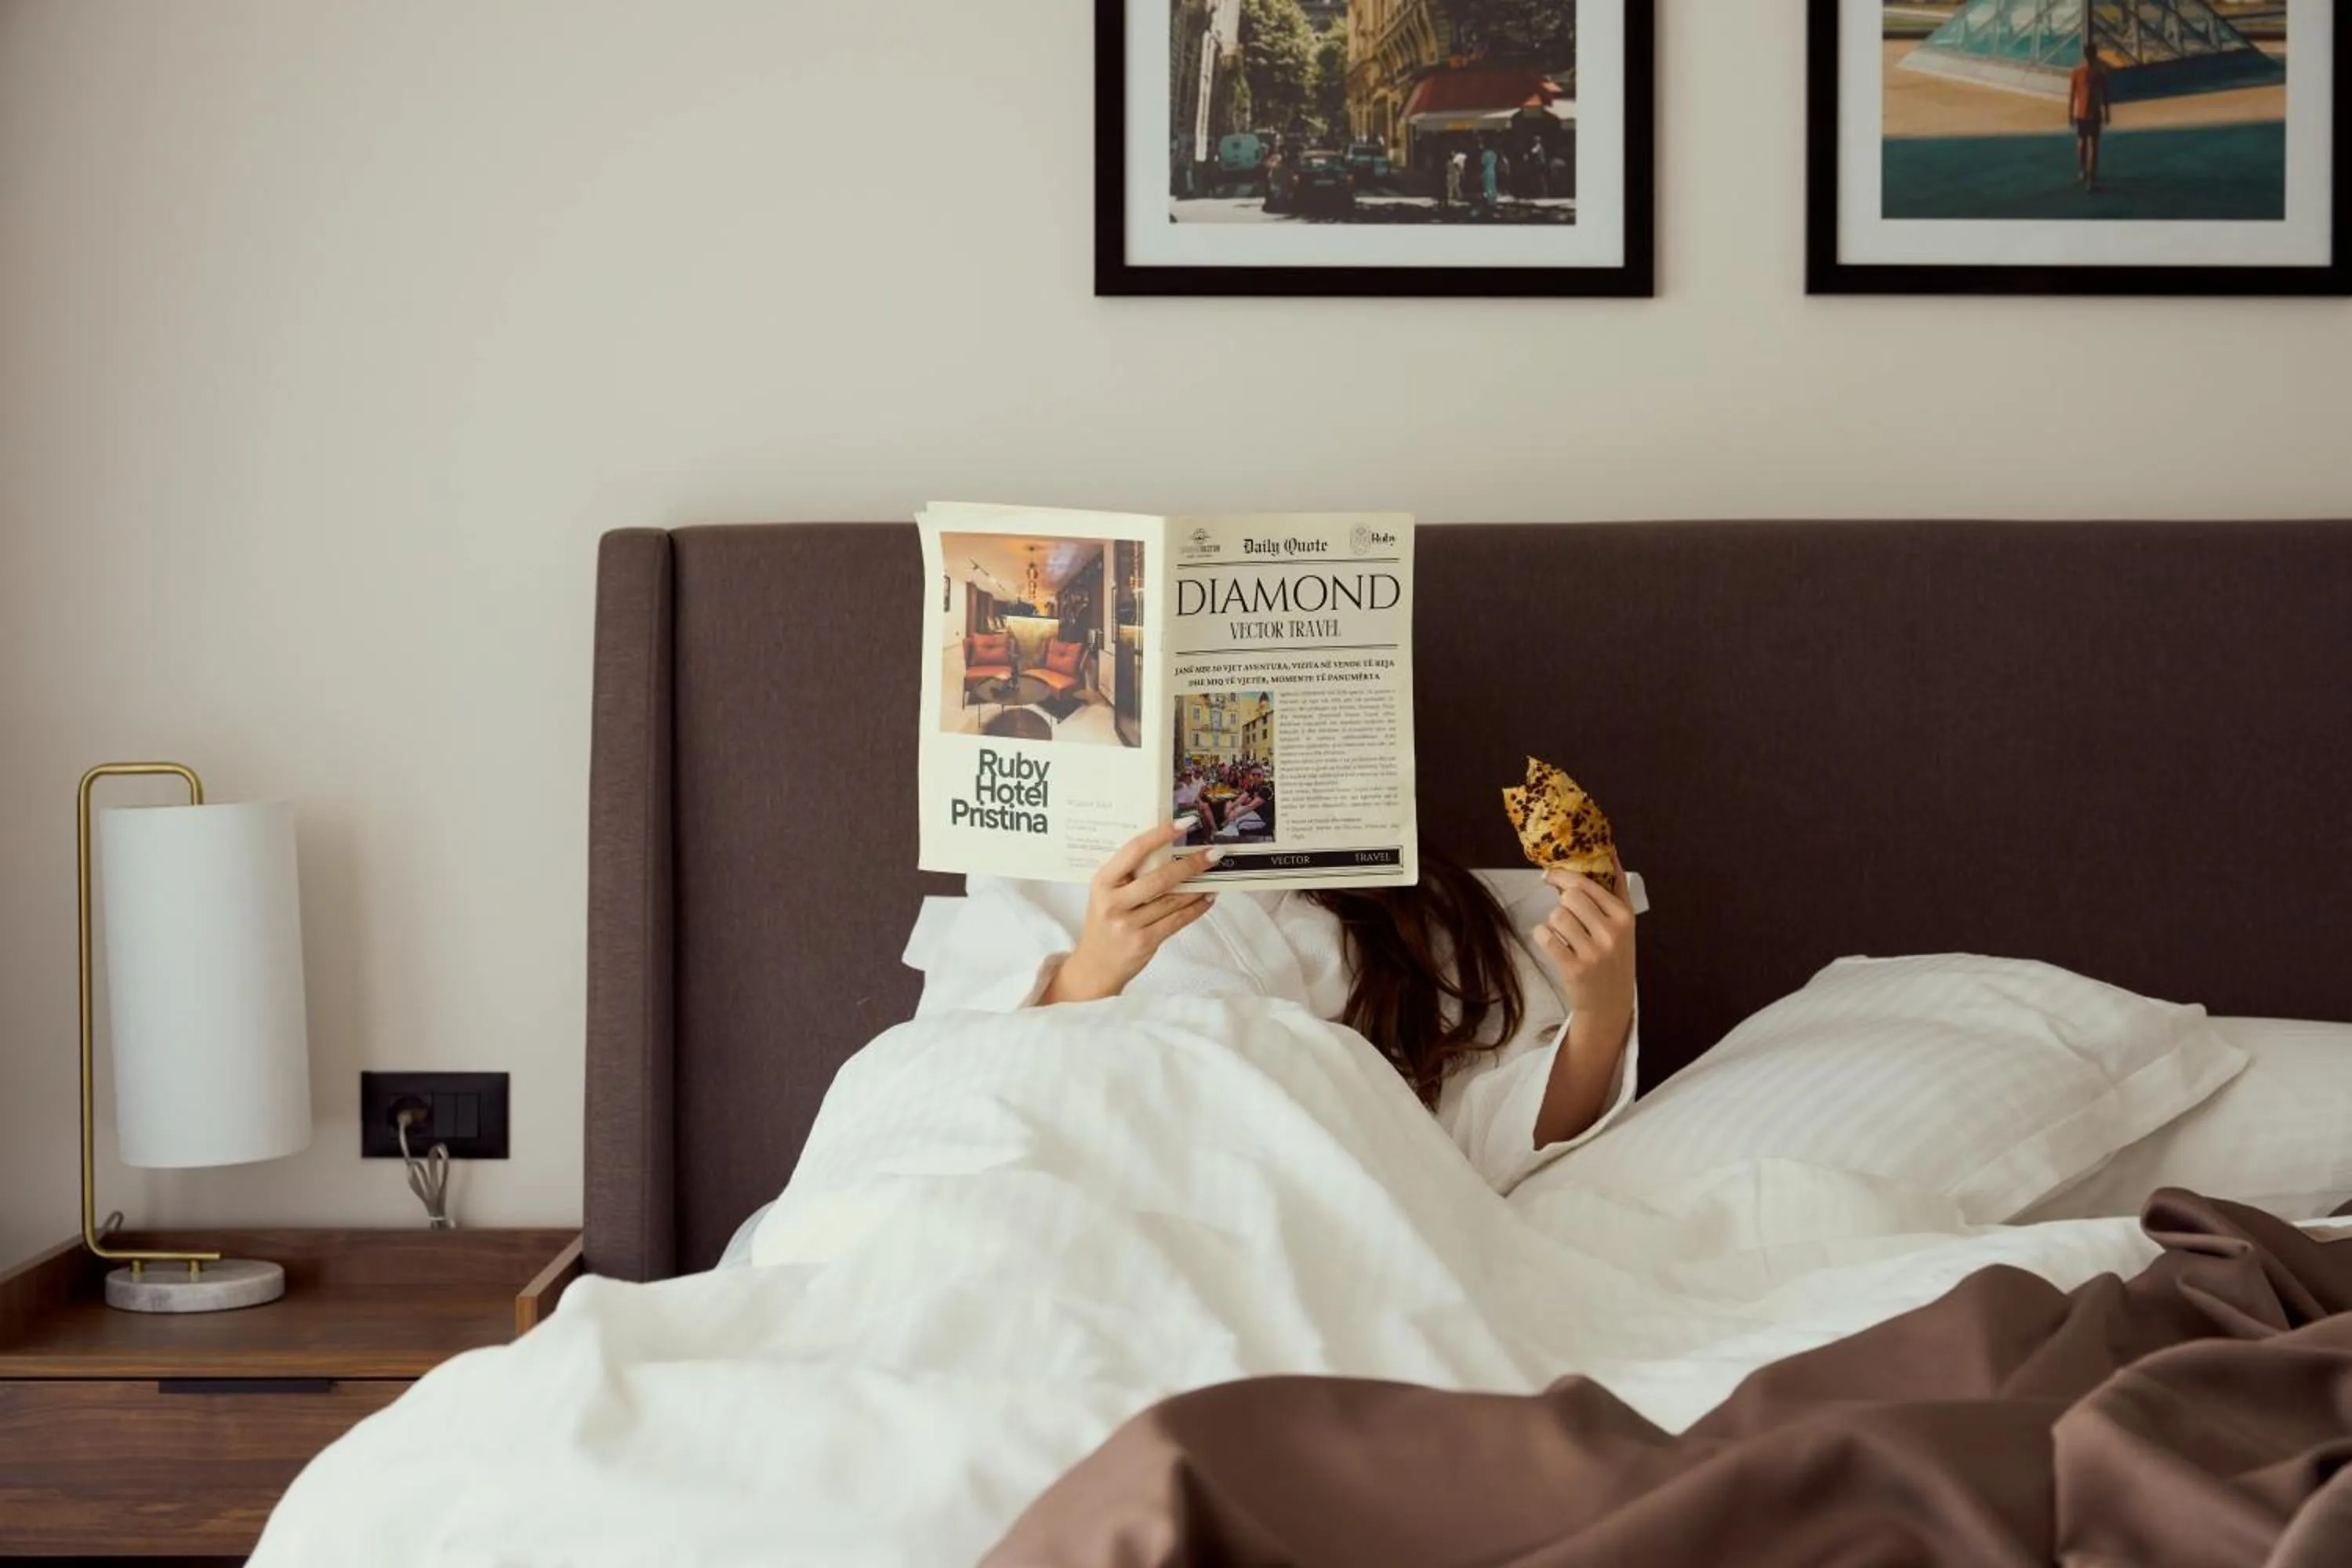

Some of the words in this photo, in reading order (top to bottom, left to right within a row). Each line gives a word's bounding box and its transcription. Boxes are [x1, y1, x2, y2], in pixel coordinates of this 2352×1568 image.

[1243, 538, 1280, 557] Daily
[1283, 537, 1328, 555] Quote
[1176, 573, 1400, 616] DIAMOND
[1229, 622, 1285, 640] VECTOR
[1289, 619, 1341, 637] TRAVEL
[979, 748, 1051, 786] Ruby
[975, 774, 1049, 808] Hotel
[951, 797, 1049, 834] Pristina
[1270, 855, 1311, 866] VECTOR
[1354, 851, 1391, 862] TRAVEL
